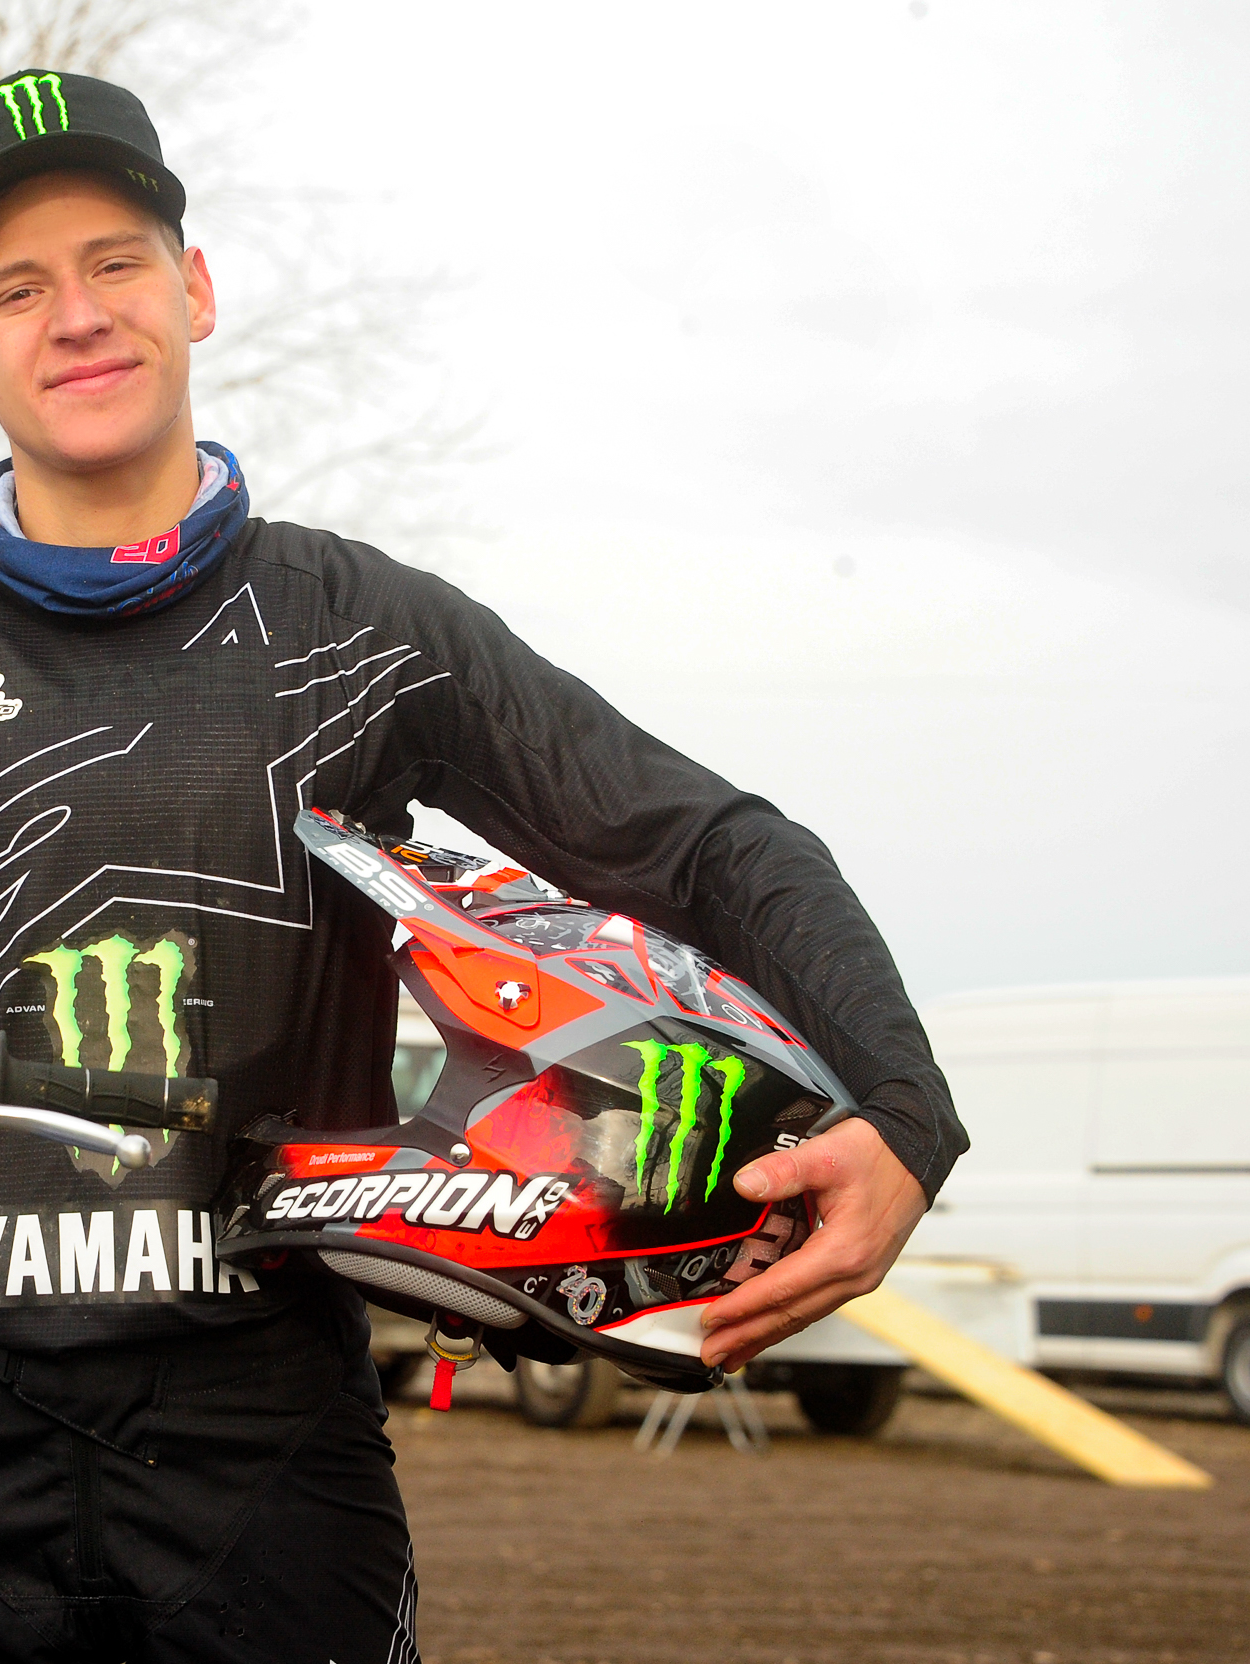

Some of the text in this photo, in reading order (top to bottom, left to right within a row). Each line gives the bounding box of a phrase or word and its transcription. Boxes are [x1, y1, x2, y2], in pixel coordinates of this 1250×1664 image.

[110, 524, 180, 564] 20
[316, 847, 404, 916] BATTERY
[321, 842, 428, 911] BS
[327, 1152, 376, 1164] Performance
[265, 1173, 556, 1234] SCORPION
[514, 1181, 570, 1239] EXO
